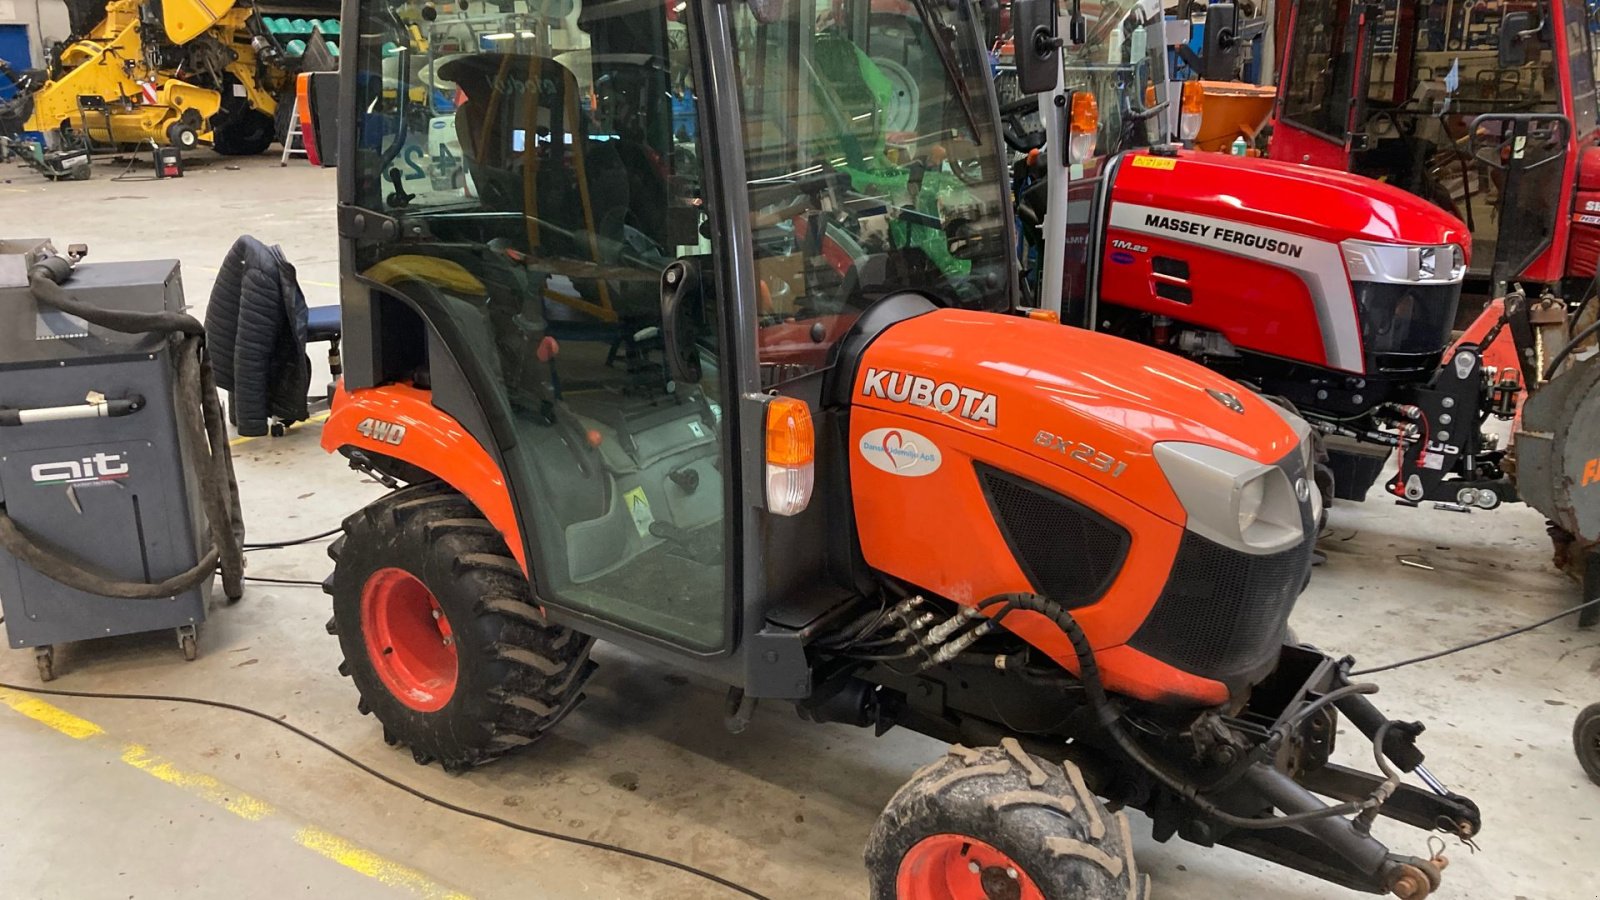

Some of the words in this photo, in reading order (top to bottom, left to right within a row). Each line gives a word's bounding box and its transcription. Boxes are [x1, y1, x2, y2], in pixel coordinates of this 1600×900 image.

[1112, 239, 1149, 253] 1M.25
[1145, 214, 1210, 236] MASSEY
[1213, 227, 1303, 258] FERGUSON
[862, 368, 997, 428] KUBOTA
[356, 416, 407, 447] 4WD
[1034, 429, 1128, 478] BX231
